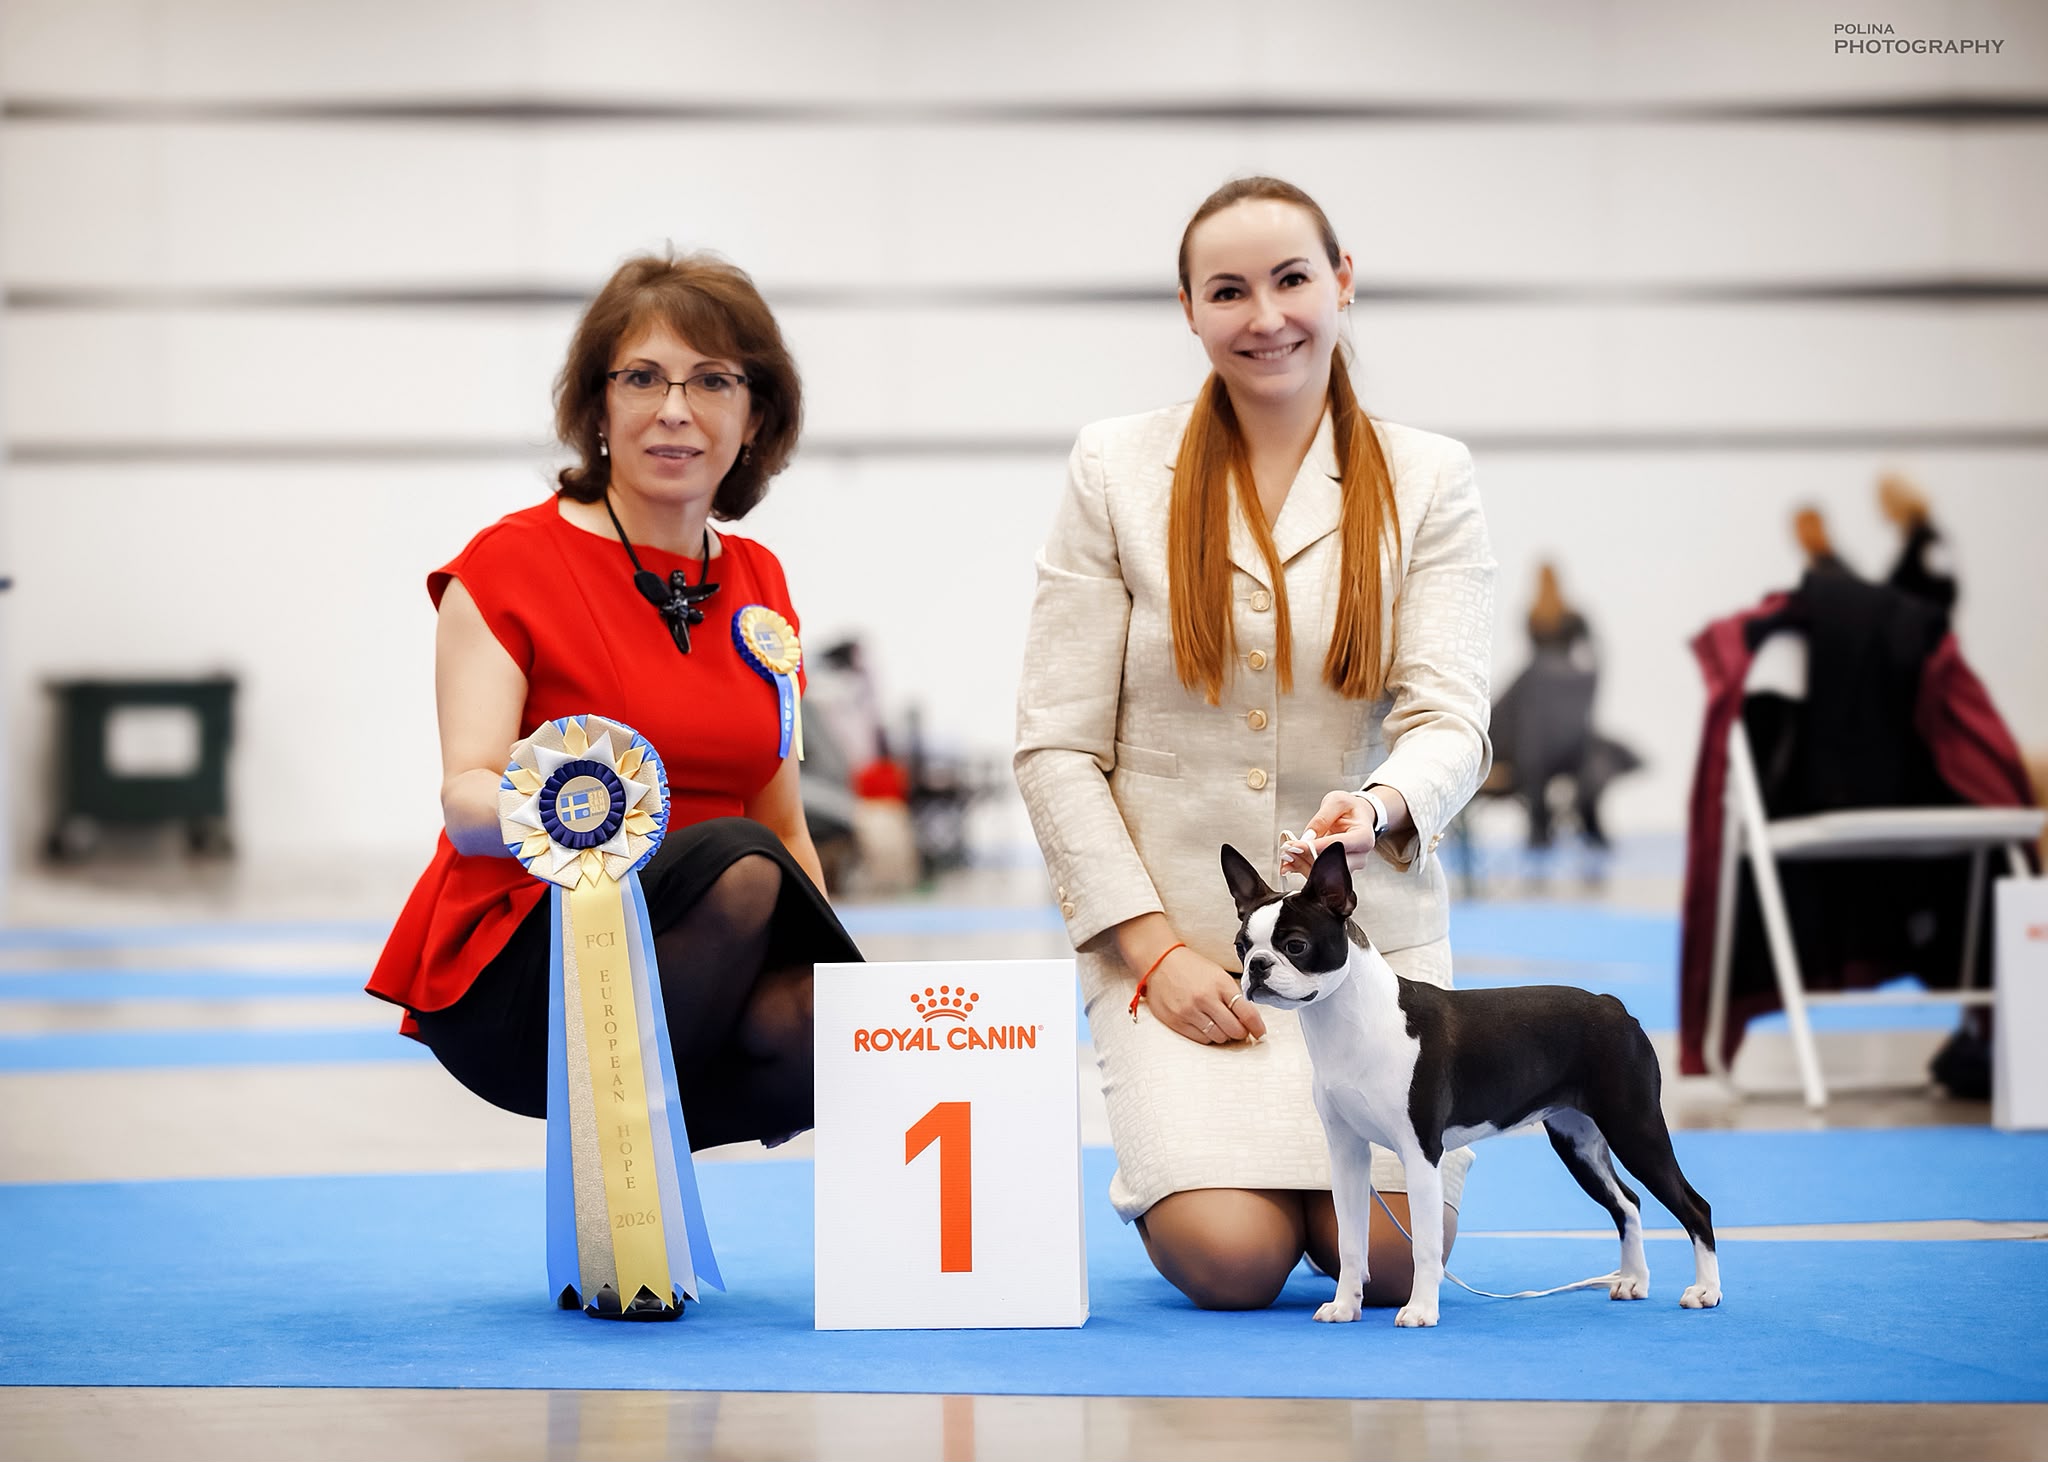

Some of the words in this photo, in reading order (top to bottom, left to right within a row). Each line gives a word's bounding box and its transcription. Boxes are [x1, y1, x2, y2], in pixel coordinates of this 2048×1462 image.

[585, 932, 616, 949] FCI
[854, 1027, 940, 1052] ROYAL
[600, 969, 626, 1103] EUROPEAN
[617, 1124, 637, 1190] HOPE
[905, 1101, 972, 1272] 1
[615, 1210, 656, 1229] 2026
